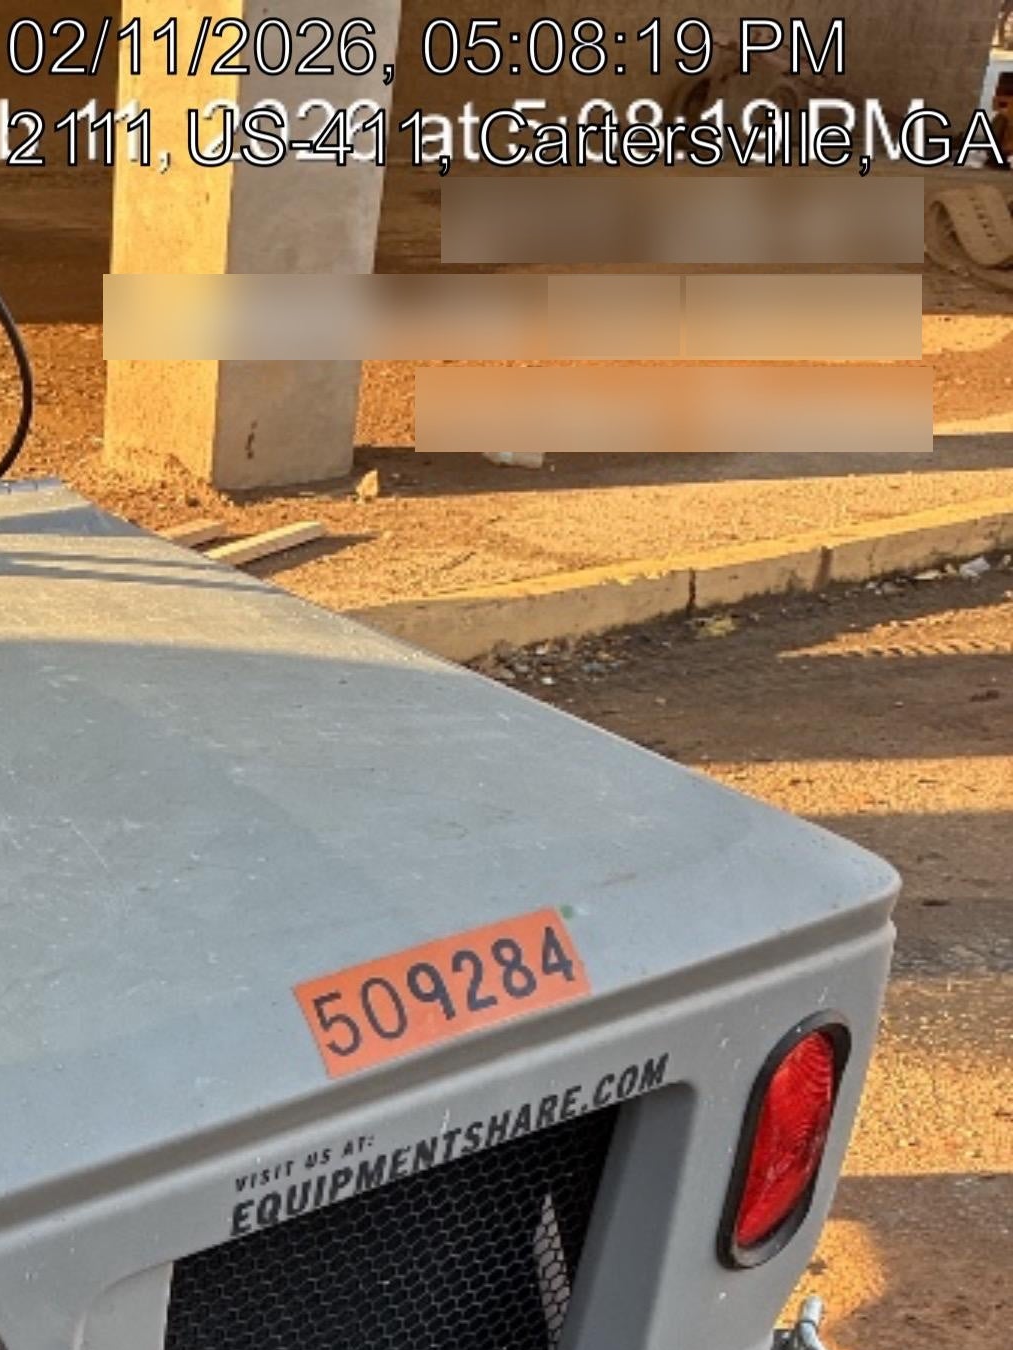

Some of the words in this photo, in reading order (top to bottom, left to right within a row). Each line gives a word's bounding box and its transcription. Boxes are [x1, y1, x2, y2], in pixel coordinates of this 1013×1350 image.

[312, 924, 576, 1057] 509284
[229, 1052, 670, 1238] EQUIPMENTSHARE.COM
[234, 1160, 295, 1193] VISIT
[304, 1148, 332, 1170] US
